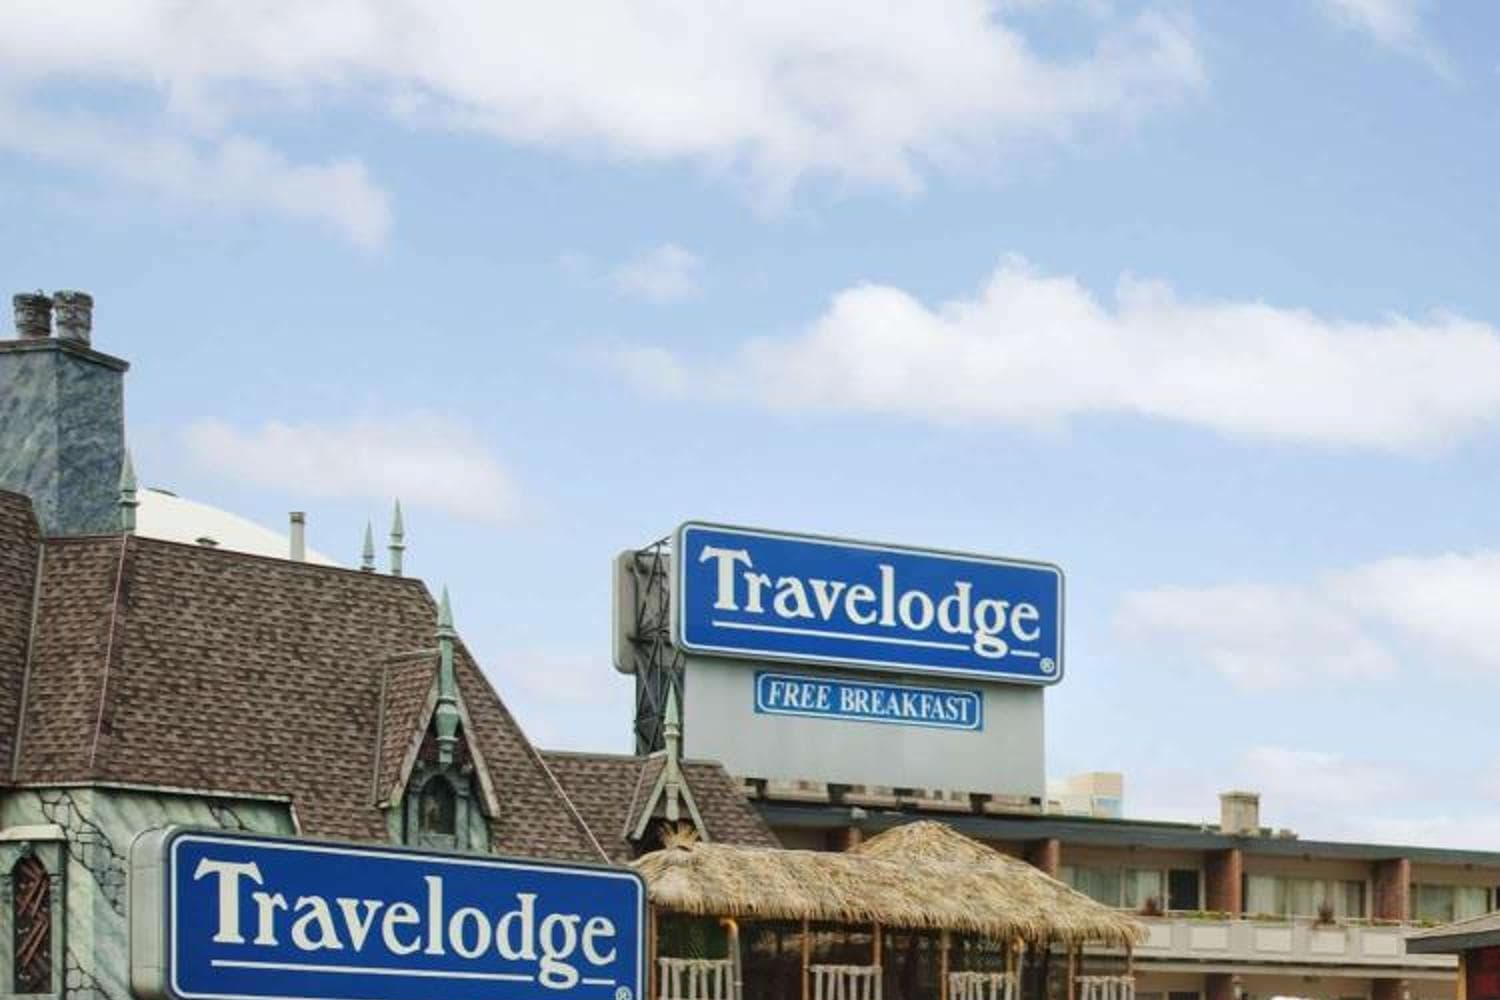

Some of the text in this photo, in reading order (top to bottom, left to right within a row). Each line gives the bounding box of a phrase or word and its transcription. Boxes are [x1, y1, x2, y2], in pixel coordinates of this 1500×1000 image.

[700, 546, 1041, 658] Travelodge
[769, 681, 971, 721] FREE BREAKFAST
[195, 857, 617, 989] Travelodge
